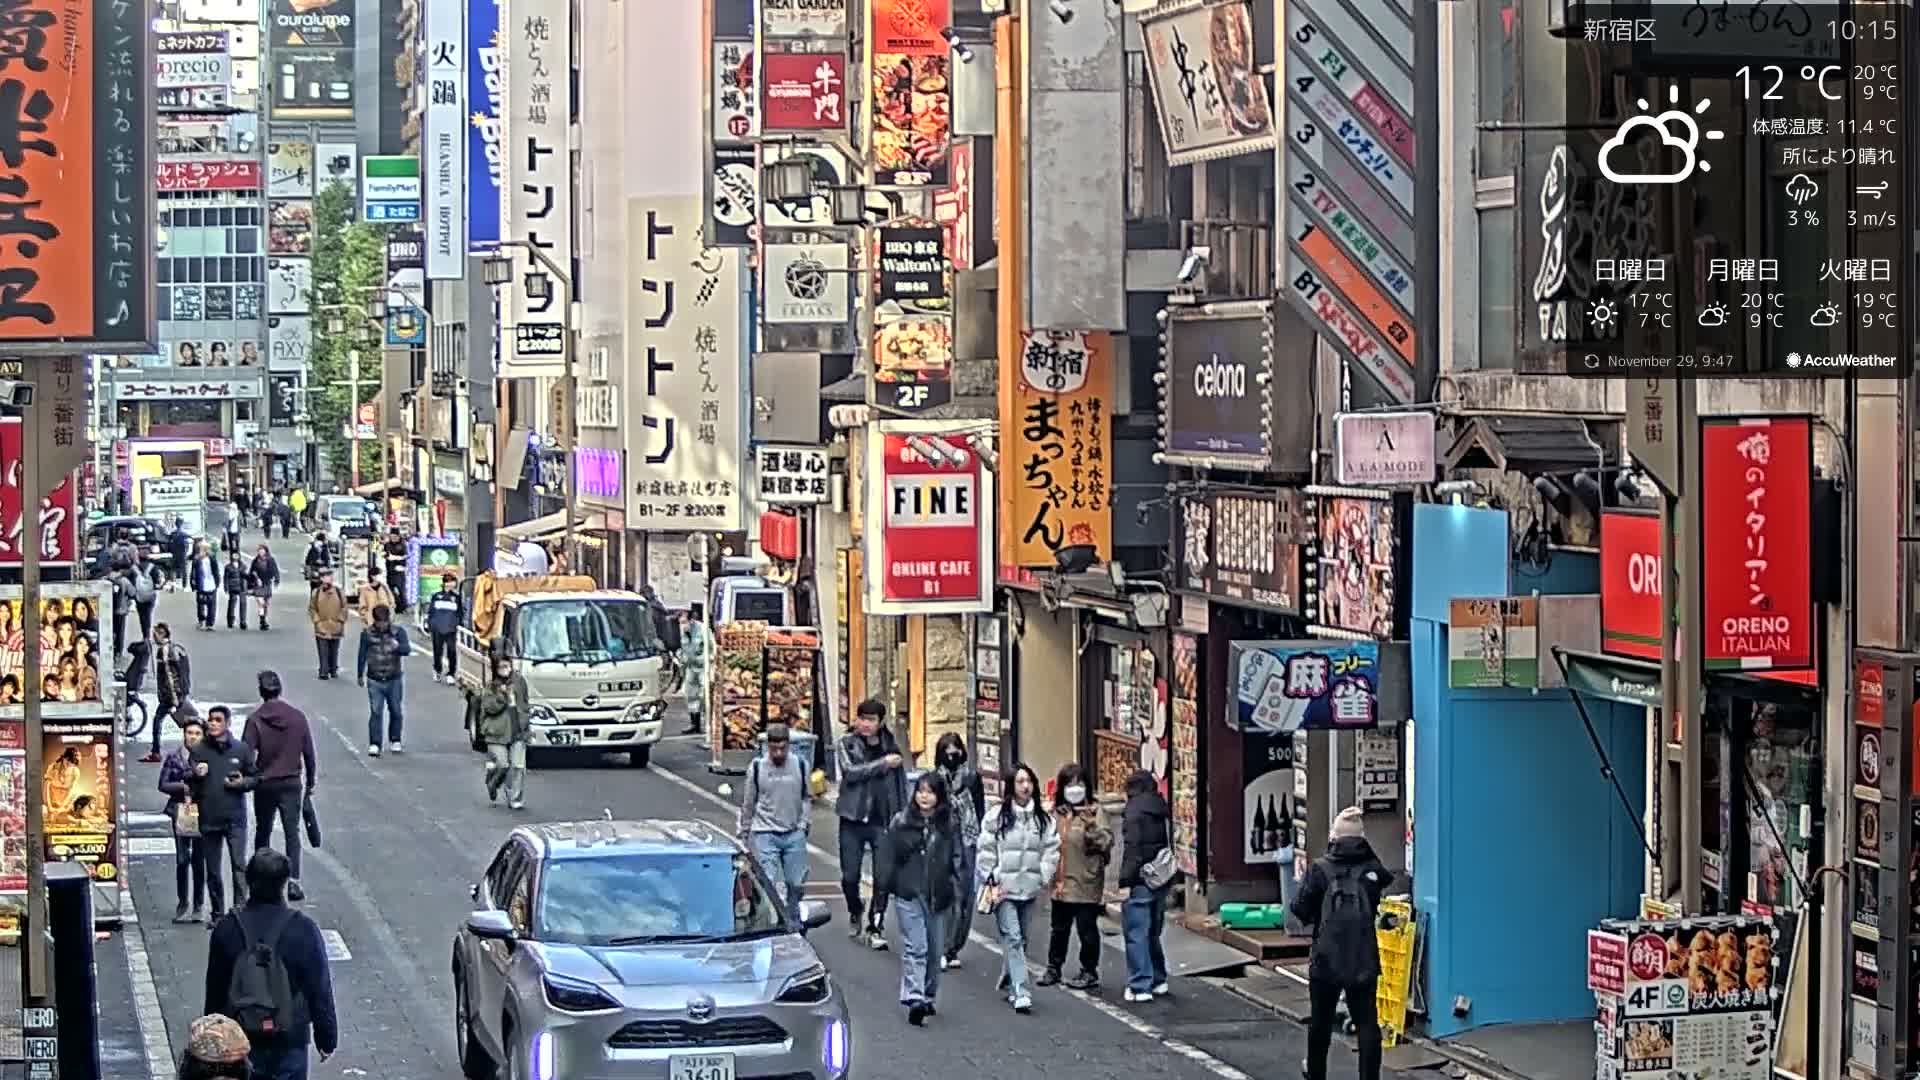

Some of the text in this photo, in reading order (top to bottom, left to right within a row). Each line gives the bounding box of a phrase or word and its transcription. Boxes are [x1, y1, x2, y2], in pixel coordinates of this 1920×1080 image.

[1296, 23, 1317, 44] 5
[431, 41, 457, 105] 火鍋
[812, 60, 841, 123] 牛門
[1296, 75, 1316, 94] 4
[1296, 123, 1316, 145] 3
[368, 184, 418, 193] FamilyMart
[1295, 173, 1316, 195] 2
[523, 137, 554, 313] トントン
[882, 257, 942, 273] Walton's
[1293, 270, 1322, 301] B1
[642, 210, 674, 464] トントン
[1025, 340, 1087, 376] 新宿
[694, 325, 719, 446] 焼とん酒場
[1194, 353, 1247, 399] celona
[53, 358, 73, 447] 通り一番街
[898, 385, 929, 406] 2F
[761, 452, 825, 472] 酒場心
[1384, 460, 1425, 472] MODE
[1023, 398, 1068, 550] まっちゃん
[761, 477, 826, 495] 新宿本店
[894, 486, 969, 515] FINE
[892, 561, 972, 578] ONLINE CAFE
[923, 580, 940, 595] B1
[1722, 616, 1790, 635] ORENO
[1721, 633, 1791, 652] ITALIAN
[1267, 747, 1292, 761] 500
[1628, 985, 1660, 1009] 4F
[24, 1007, 55, 1028] NERO
[26, 1036, 57, 1058] NERO
